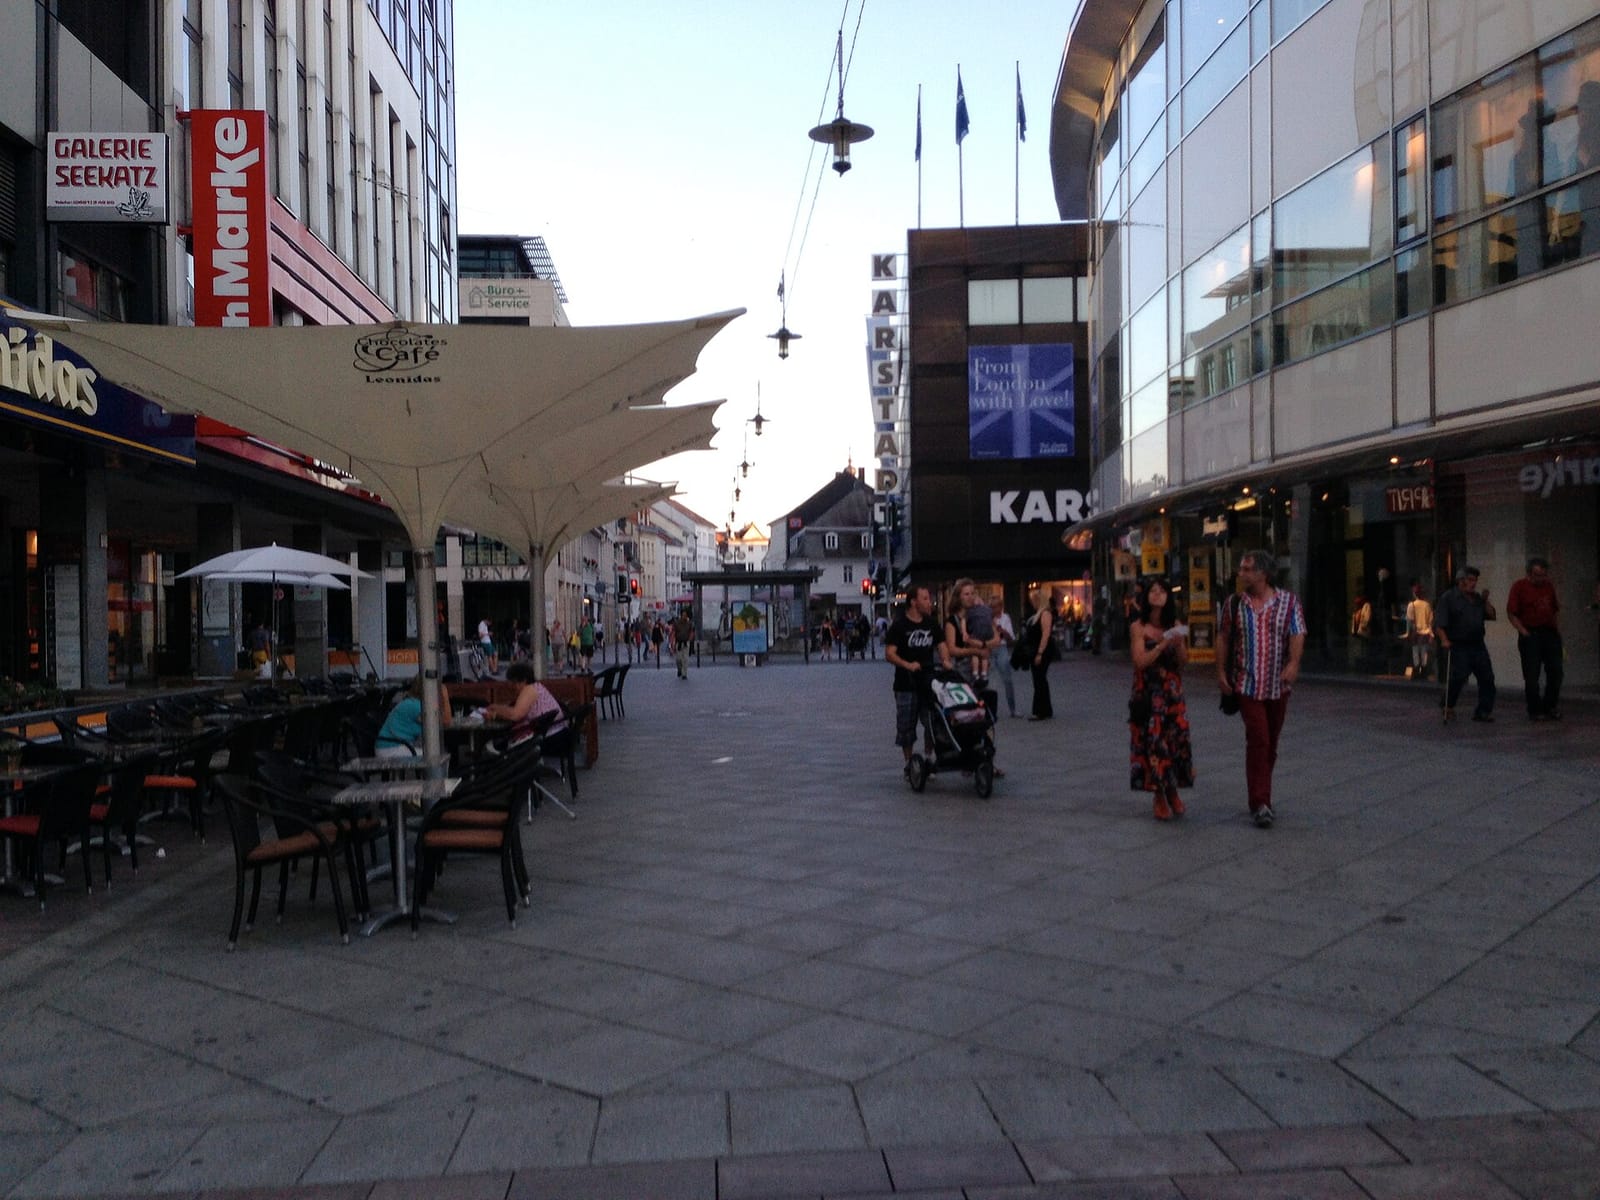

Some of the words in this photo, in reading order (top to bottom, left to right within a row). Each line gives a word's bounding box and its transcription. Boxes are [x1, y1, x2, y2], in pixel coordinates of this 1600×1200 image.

[54, 139, 152, 161] GALERIE
[55, 165, 158, 188] SEEKATZ
[211, 117, 260, 297] Marke
[487, 298, 529, 309] Service
[375, 345, 440, 364] Café
[974, 357, 1021, 375] From
[365, 374, 441, 383] Leonidas
[975, 375, 1047, 392] London
[974, 391, 1013, 409] with
[1020, 389, 1070, 409] Love!
